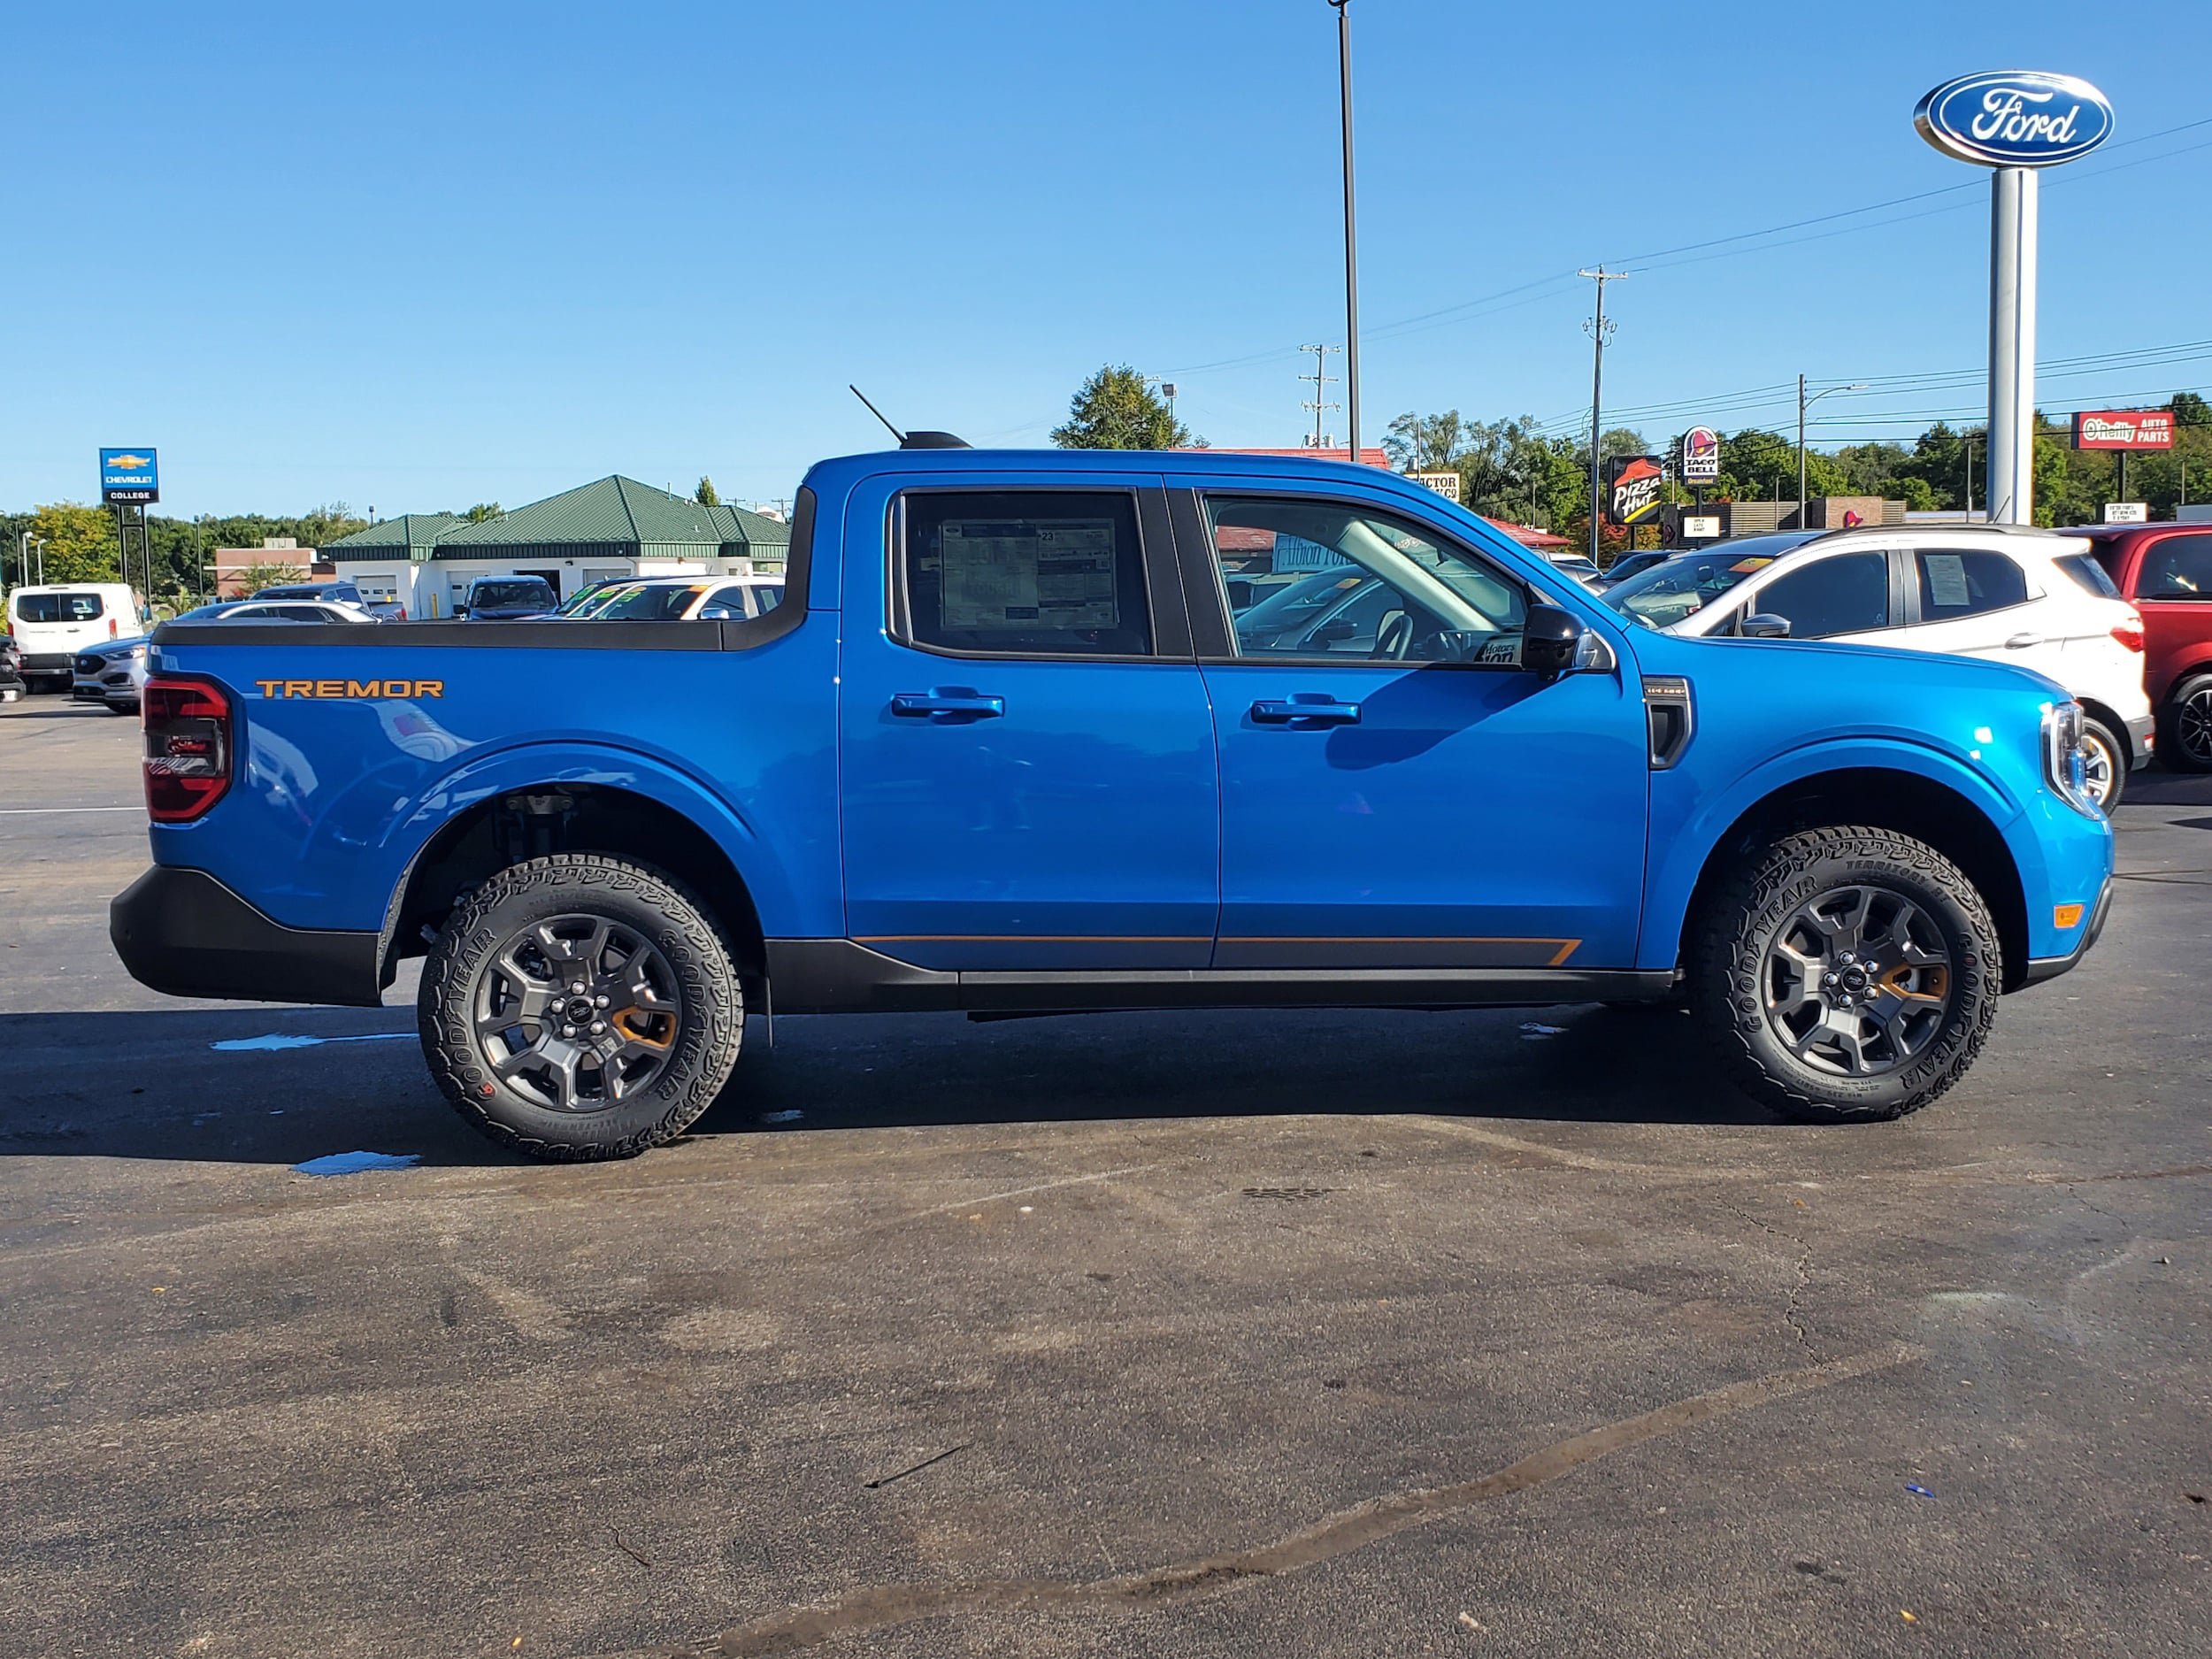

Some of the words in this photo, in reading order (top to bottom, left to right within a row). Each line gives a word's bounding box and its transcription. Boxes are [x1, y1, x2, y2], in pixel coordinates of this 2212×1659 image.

[1971, 88, 2080, 143] Ford
[2083, 419, 2135, 442] O'Reilly
[2140, 419, 2168, 430] AUTO
[2137, 431, 2170, 442] PARTS
[1613, 477, 1661, 512] Pizza
[1621, 490, 1657, 517] Hut
[256, 680, 444, 698] TREMOR
